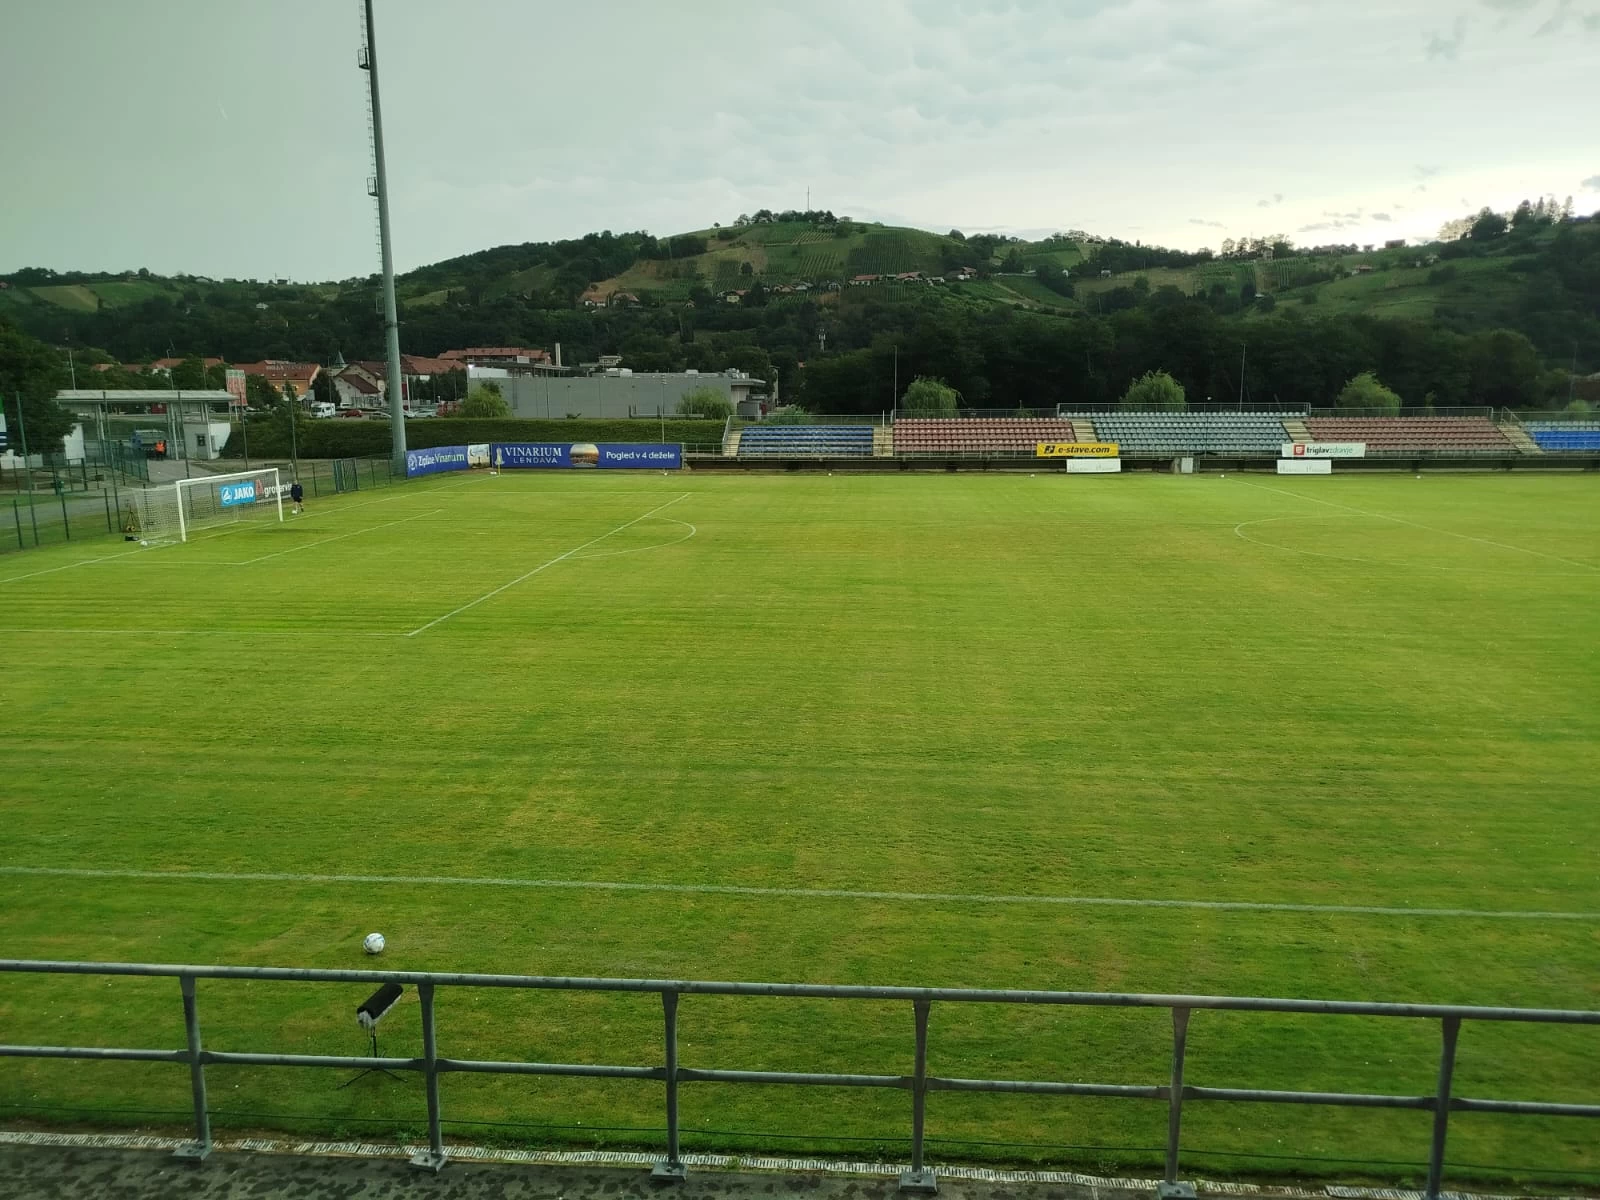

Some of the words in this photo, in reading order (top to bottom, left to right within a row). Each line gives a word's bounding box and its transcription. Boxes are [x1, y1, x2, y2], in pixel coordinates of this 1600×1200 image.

[505, 447, 562, 457] VINARIUM
[1058, 446, 1110, 454] e-stave.com
[606, 451, 634, 461] Pogled
[642, 451, 647, 459] 4
[648, 451, 675, 459] dežele
[233, 486, 254, 500] JAKO
